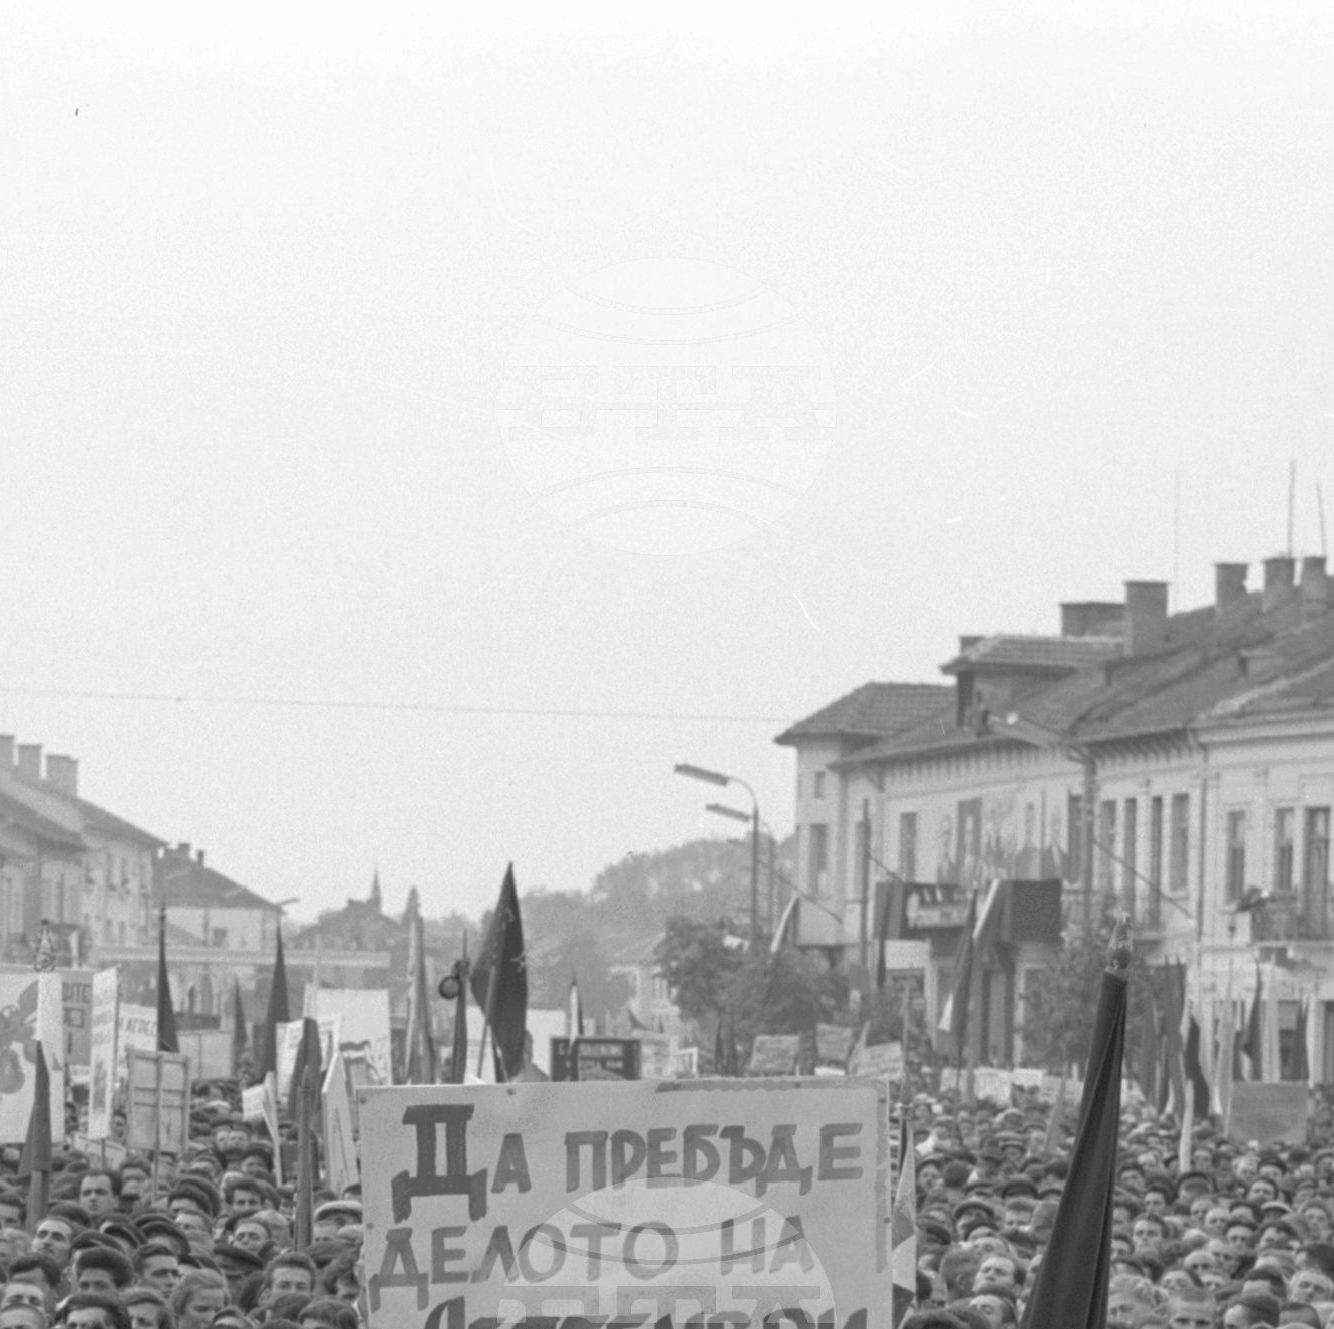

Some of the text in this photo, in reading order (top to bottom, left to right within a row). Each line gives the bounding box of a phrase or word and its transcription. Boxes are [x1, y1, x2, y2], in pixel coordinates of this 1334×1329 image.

[391, 1103, 864, 1224] ДА ПРЕБЪДЕ
[367, 1215, 815, 1312] ДЕЛОТО НА
